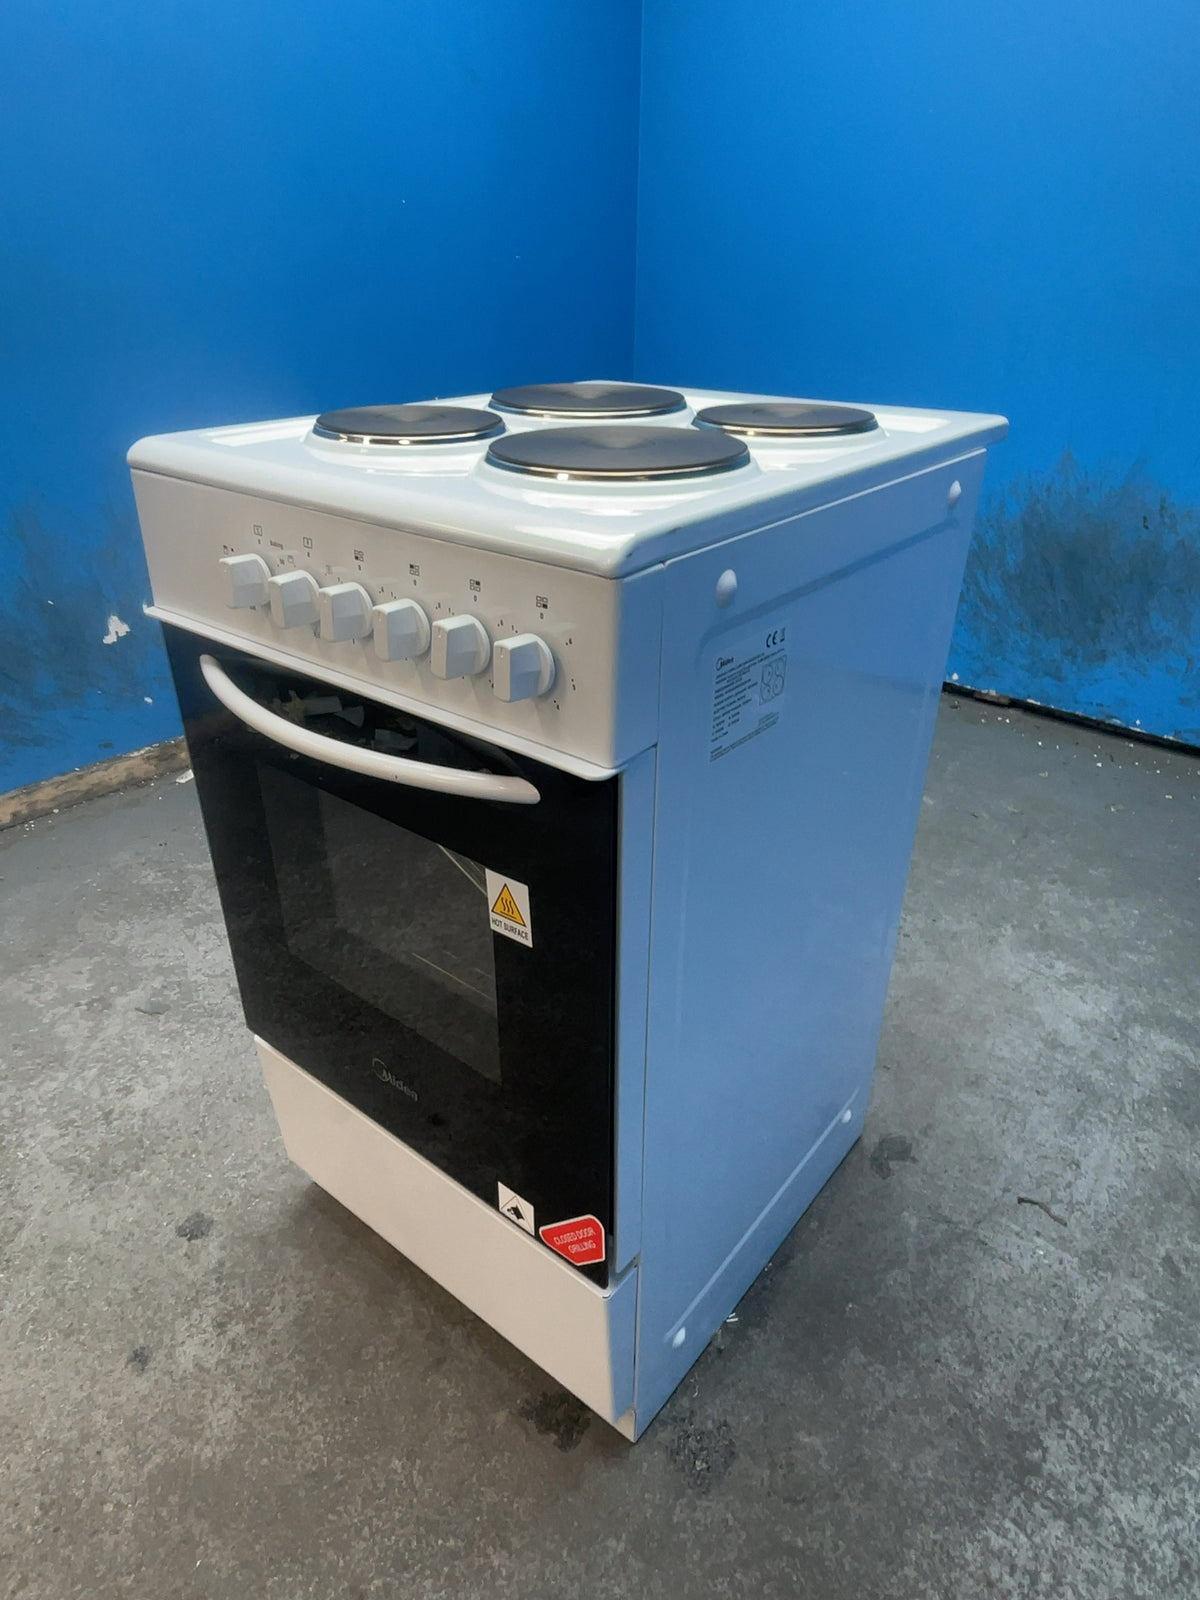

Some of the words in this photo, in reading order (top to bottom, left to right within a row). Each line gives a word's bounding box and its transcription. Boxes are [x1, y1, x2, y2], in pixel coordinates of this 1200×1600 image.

[492, 917, 502, 928] HOT
[504, 923, 529, 940] SURFACE
[576, 1227, 596, 1239] DOOR
